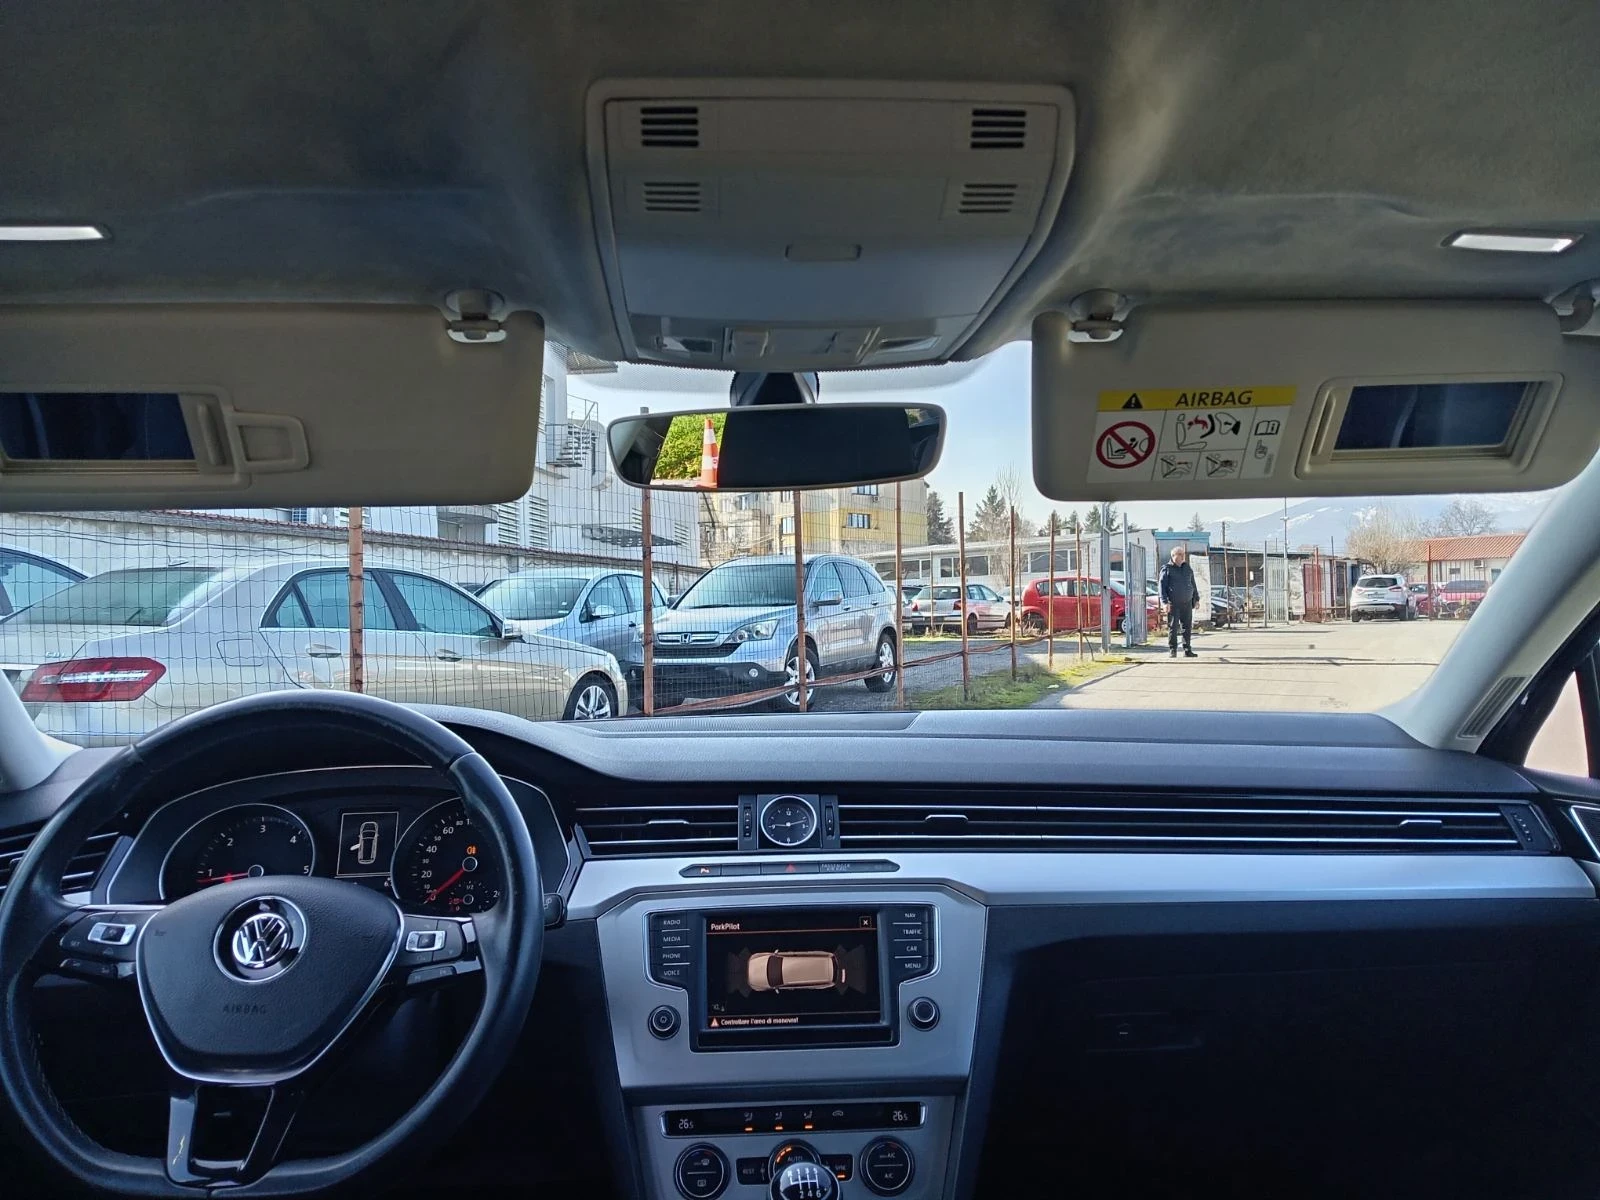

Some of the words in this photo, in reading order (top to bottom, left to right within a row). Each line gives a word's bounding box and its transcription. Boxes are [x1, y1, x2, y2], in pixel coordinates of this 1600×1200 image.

[1175, 390, 1253, 407] AIRBAG
[260, 825, 266, 833] 3
[227, 838, 234, 846] 2
[208, 868, 213, 877] 1
[303, 865, 309, 874] 5
[799, 1191, 805, 1199] 2
[807, 1190, 813, 1198] 4
[816, 1190, 822, 1198] 6
